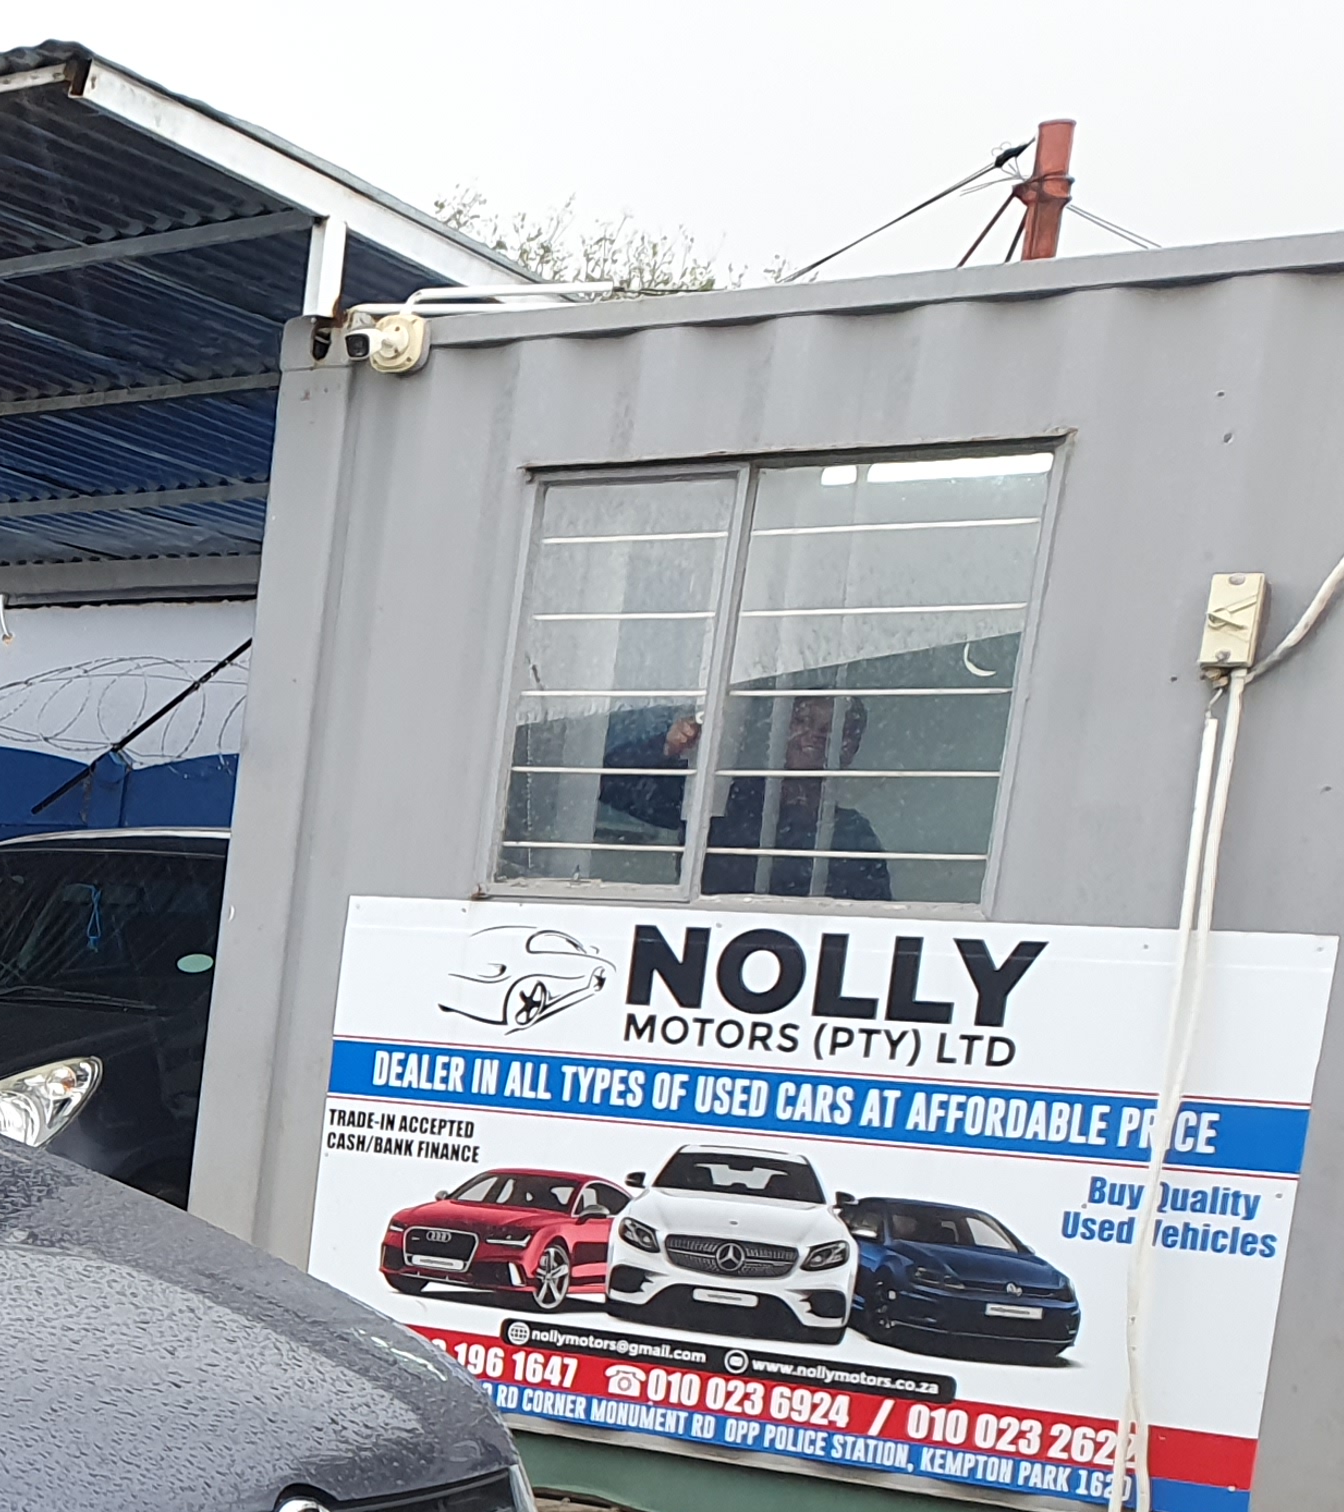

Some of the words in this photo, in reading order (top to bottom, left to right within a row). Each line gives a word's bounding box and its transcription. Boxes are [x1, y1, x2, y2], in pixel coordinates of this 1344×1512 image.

[624, 924, 1050, 1028] NOLLY
[622, 1012, 800, 1053] MOTORS
[812, 1022, 923, 1067] (PTY)
[936, 1032, 1017, 1067] LTD
[328, 1108, 396, 1132] TRADE-IN
[398, 1115, 475, 1139] ACCEPTED
[372, 1049, 465, 1092] DEALER
[471, 1058, 500, 1095] IN
[504, 1060, 552, 1100] ALL
[561, 1064, 646, 1107] TYPES
[652, 1071, 691, 1110] OF
[694, 1075, 769, 1118] USED
[775, 1081, 855, 1125] CARS
[858, 1087, 901, 1129] AT
[905, 1090, 1111, 1146] AFFORDABLE
[1116, 1107, 1221, 1155] PRCE
[326, 1131, 414, 1158] CASH/BANK
[417, 1140, 480, 1163] FINANCE
[1087, 1175, 1146, 1210] Buy
[1061, 1210, 1136, 1245] Used
[1151, 1217, 1278, 1258] ehicles
[454, 1341, 505, 1378] 196
[512, 1350, 578, 1388] 1647
[531, 1329, 706, 1364] nollymotors@gmail.com
[751, 1357, 939, 1395] www.nollymotors.co.za
[646, 1368, 702, 1406] 010
[705, 1376, 765, 1416] 023
[769, 1386, 850, 1428] 6924
[906, 1403, 969, 1445] 010
[974, 1412, 1043, 1455] 023
[496, 1384, 519, 1409] RD
[522, 1388, 588, 1420] CORNER
[590, 1397, 689, 1433] MONUMENT
[691, 1412, 716, 1439] RD
[724, 1417, 760, 1446] OPP
[763, 1424, 829, 1456] POLICE
[831, 1431, 914, 1473] STATION,
[920, 1446, 1014, 1485] KEMPTON
[1017, 1463, 1072, 1492] PARK
